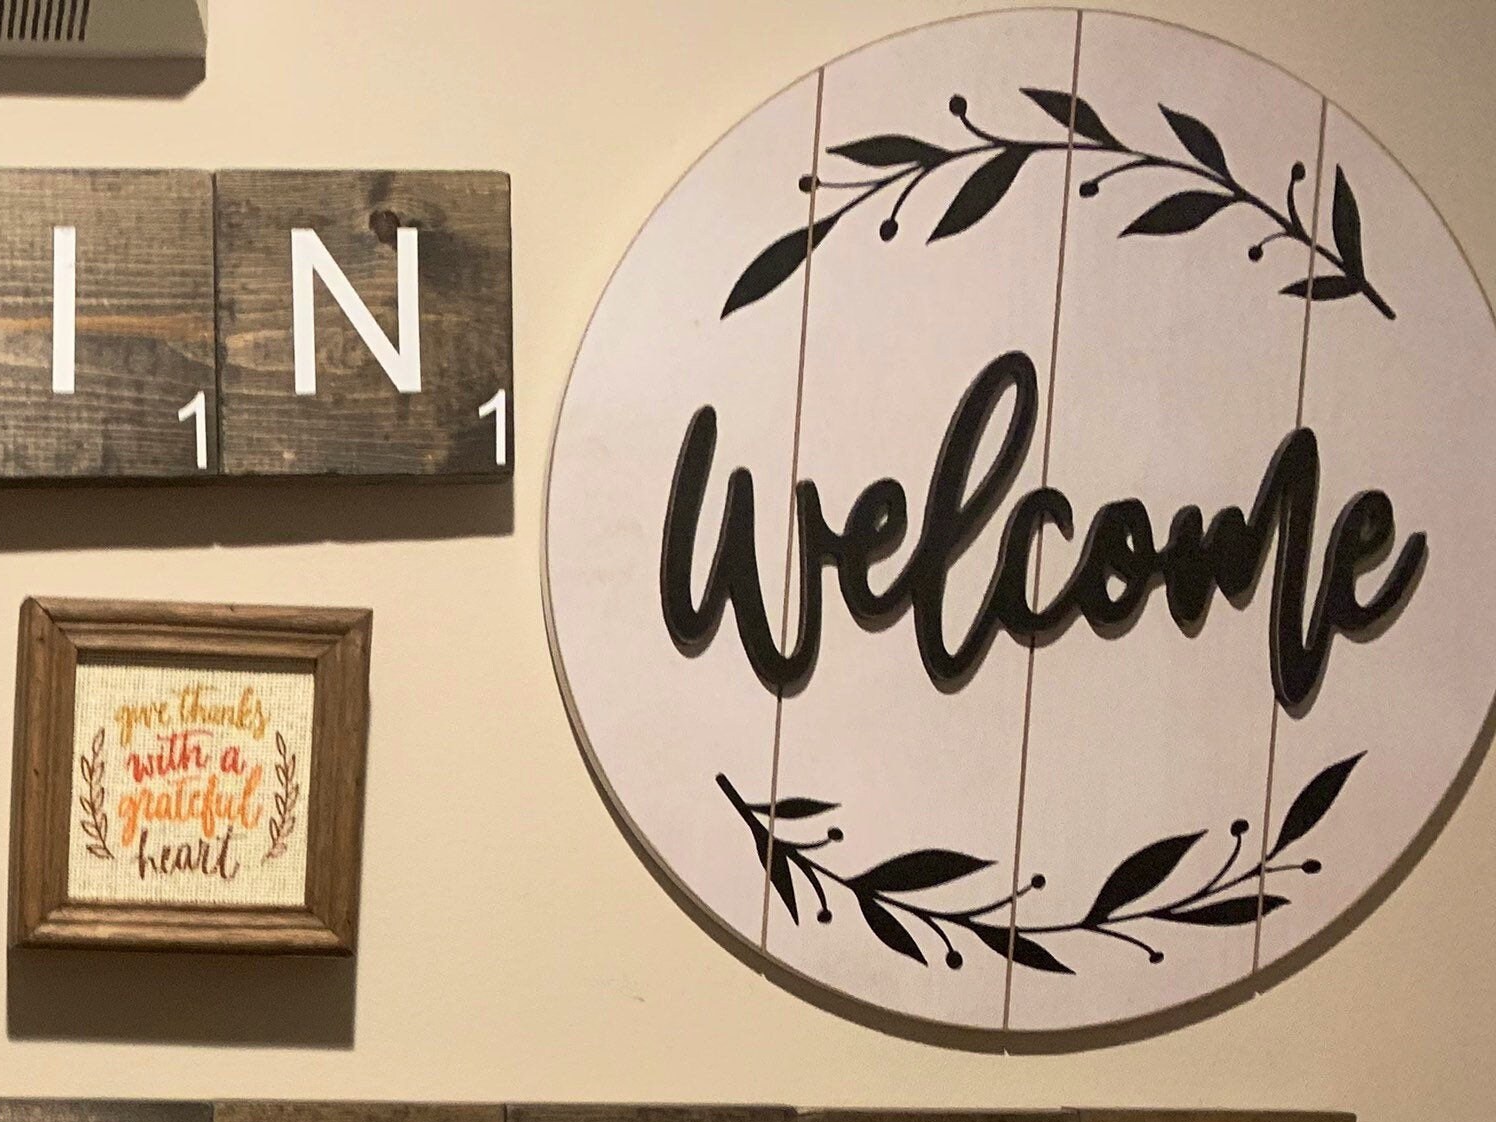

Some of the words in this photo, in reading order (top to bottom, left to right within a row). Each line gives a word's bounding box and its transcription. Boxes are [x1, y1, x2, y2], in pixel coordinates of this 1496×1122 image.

[176, 389, 208, 468] 1
[477, 387, 507, 466] 1
[128, 728, 214, 783] with
[219, 745, 247, 776] a
[118, 764, 263, 847] grateful
[138, 825, 241, 880] heart
